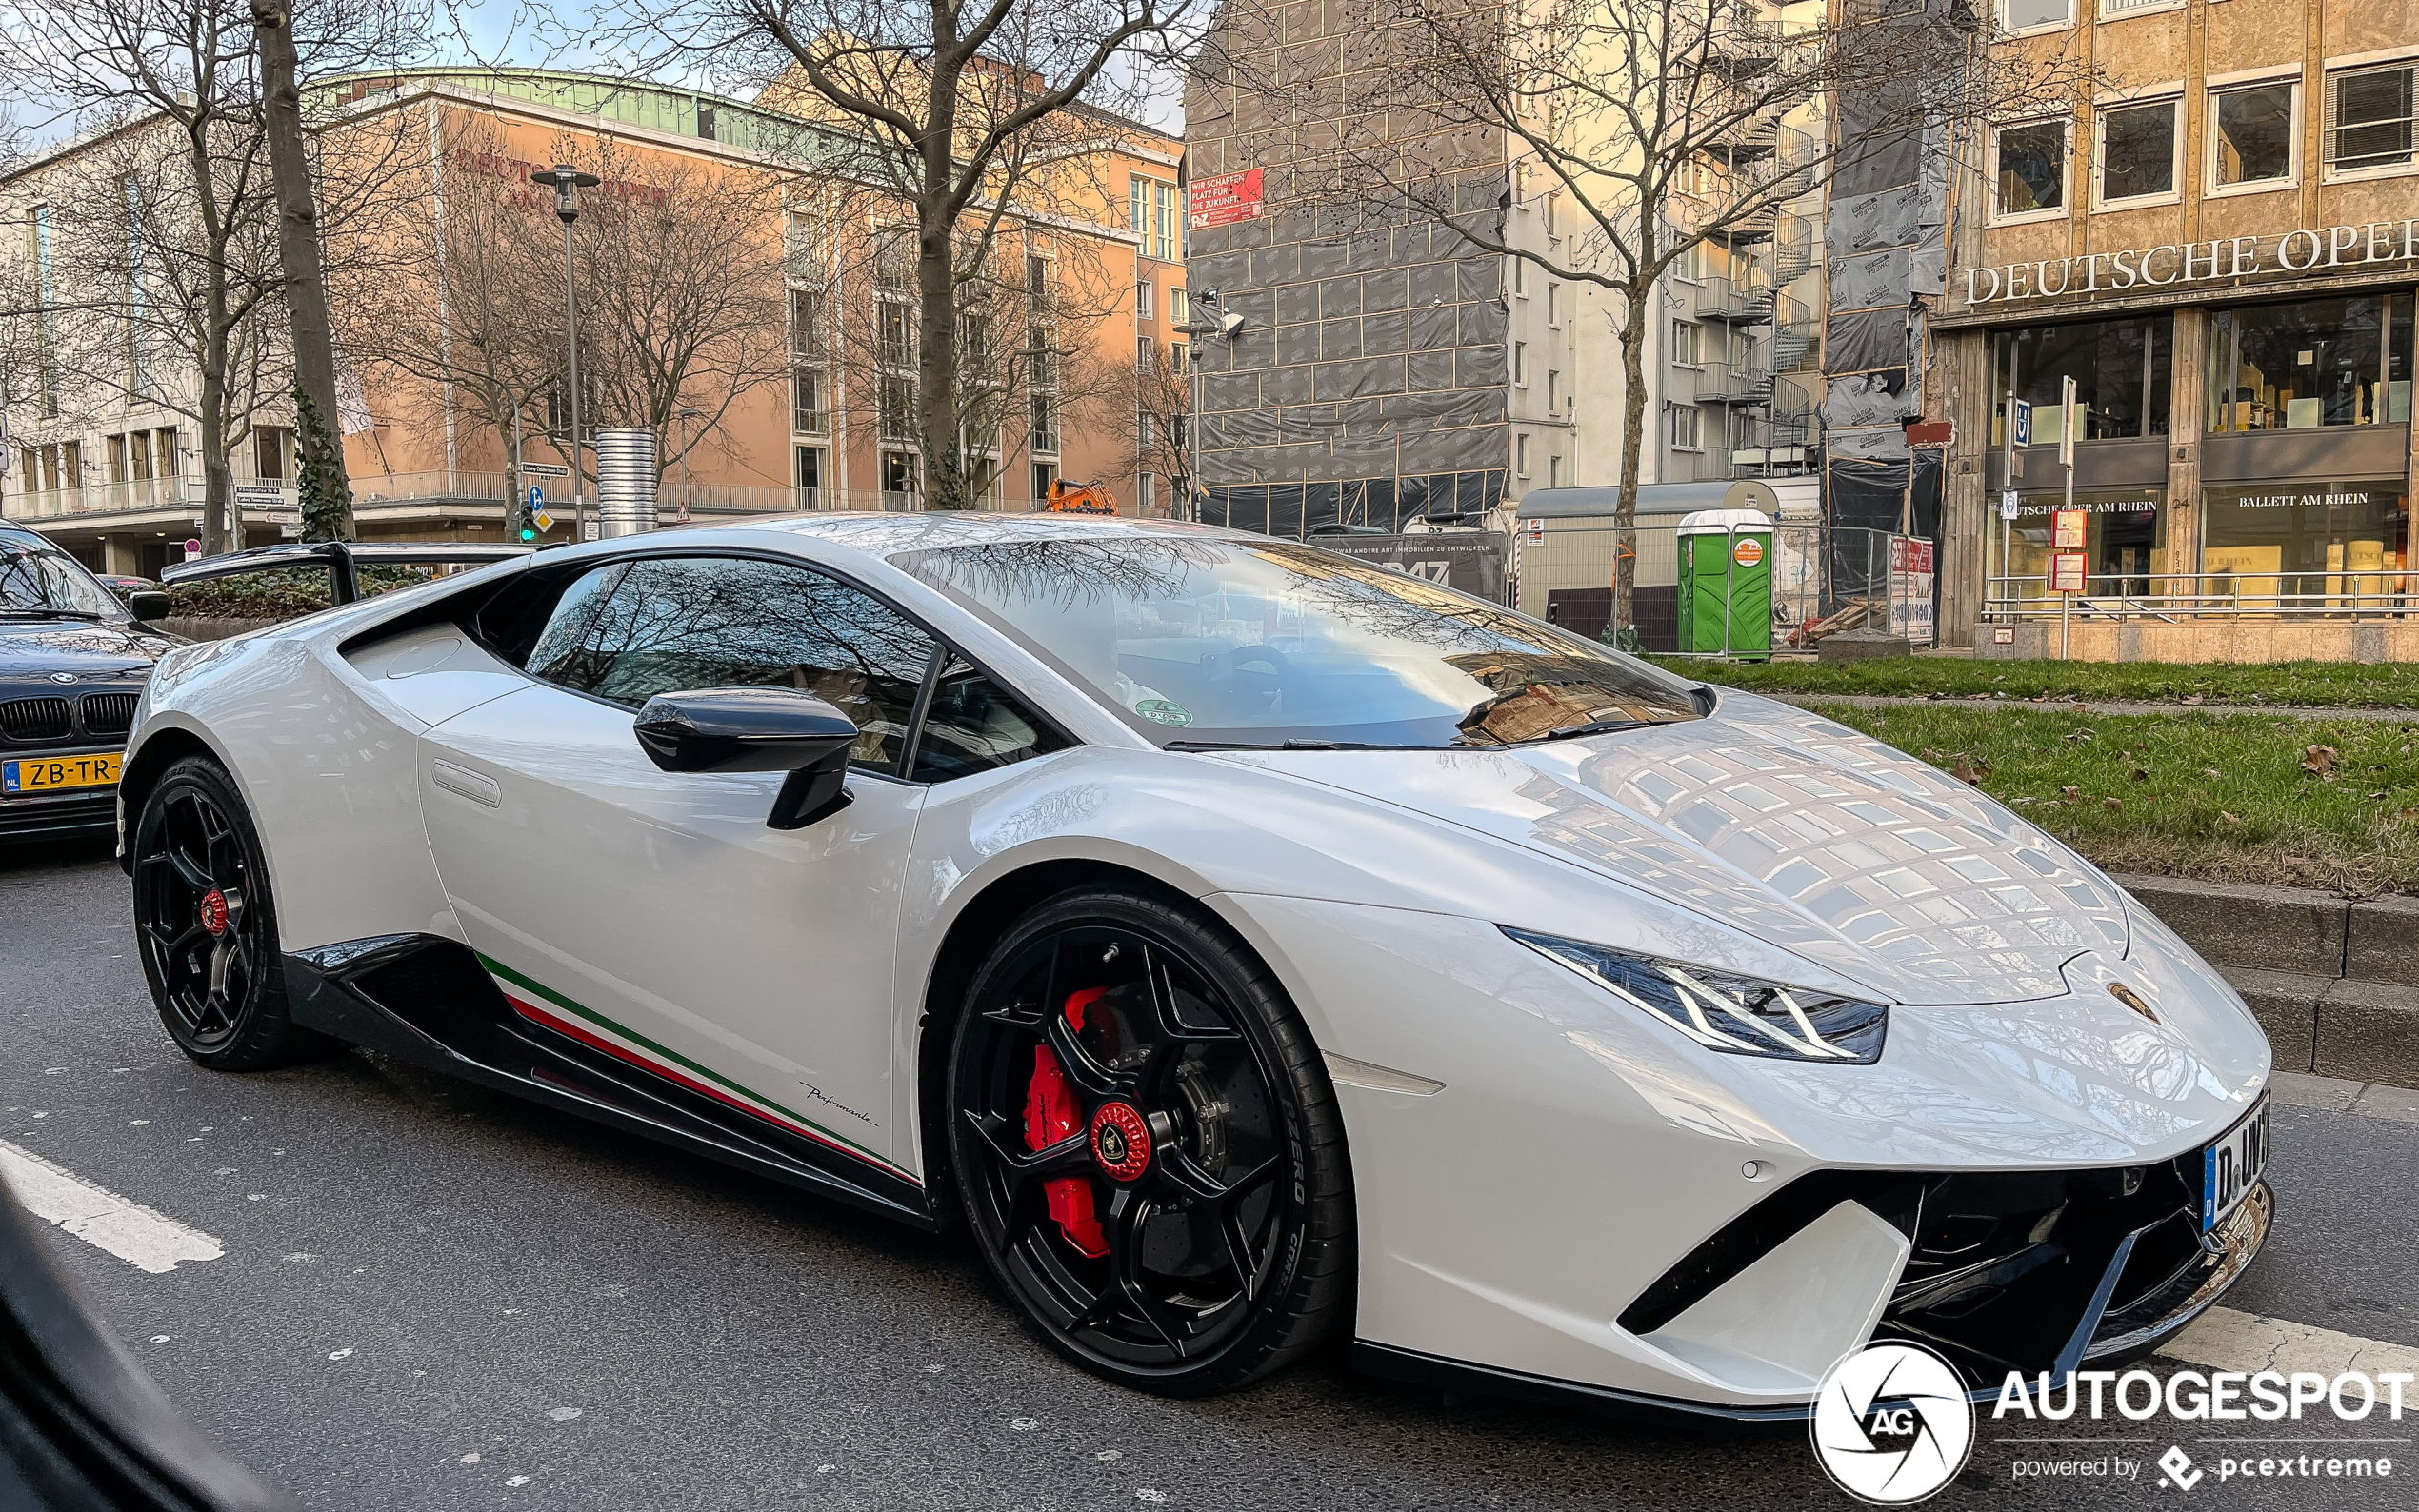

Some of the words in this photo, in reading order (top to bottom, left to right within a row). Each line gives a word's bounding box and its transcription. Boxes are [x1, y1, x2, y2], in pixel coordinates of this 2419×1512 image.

[1192, 182, 1205, 190] WIR
[1207, 173, 1245, 188] SCHAFFEN
[1192, 189, 1211, 201] PLATZ
[1213, 187, 1228, 197] FÜR
[1192, 202, 1203, 210] DIE
[1205, 195, 1239, 209] ZUKUNFT.
[1852, 228, 1875, 243] OMEGA
[1963, 235, 2261, 305] DEUTSCHE
[1865, 284, 1888, 299] OMEGA
[2096, 502, 2115, 512] AM
[2118, 501, 2158, 512] RHEIN
[2172, 498, 2189, 508] 24
[2239, 495, 2297, 507] BALLETT
[2300, 494, 2321, 506] AM
[2326, 492, 2369, 505] RHEIN
[7, 779, 18, 787] NL
[798, 1080, 879, 1127] Performante
[2218, 1145, 2232, 1211] D
[2206, 1199, 2211, 1217] D
